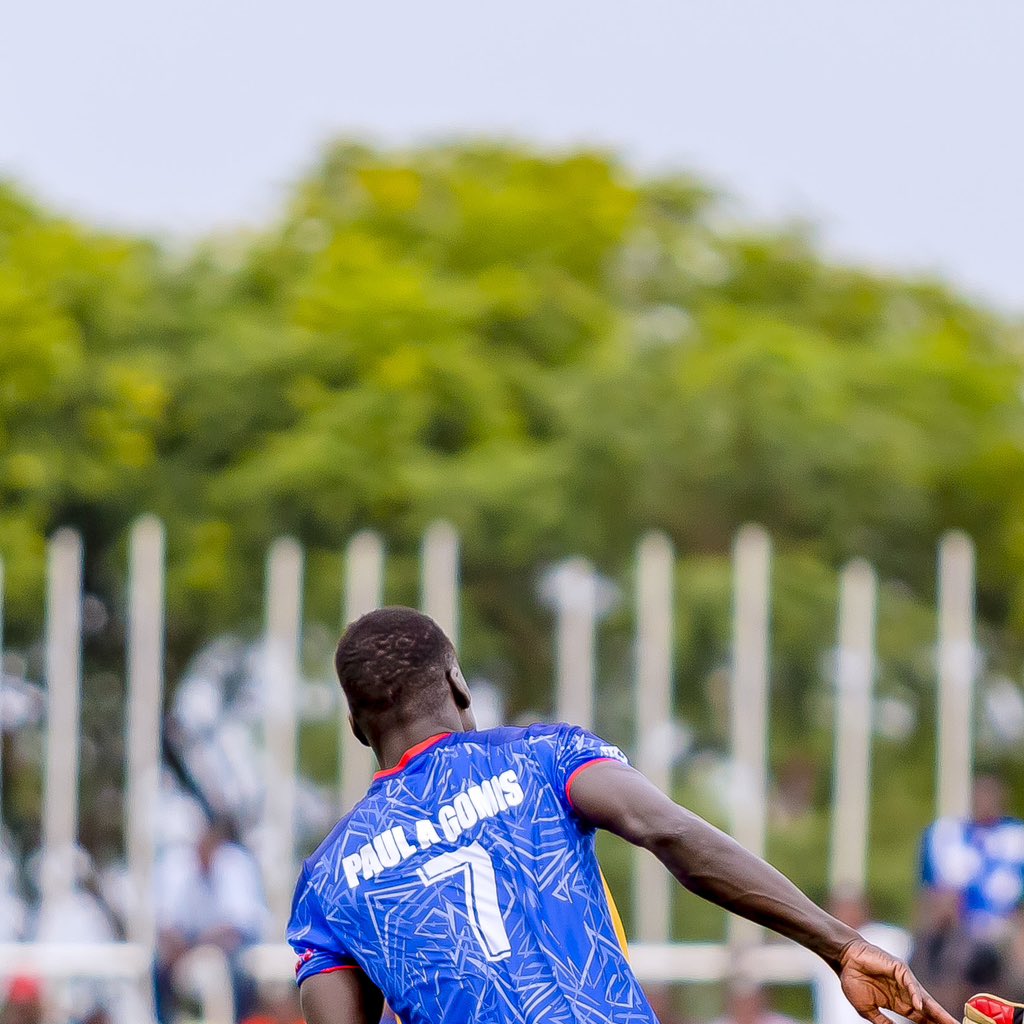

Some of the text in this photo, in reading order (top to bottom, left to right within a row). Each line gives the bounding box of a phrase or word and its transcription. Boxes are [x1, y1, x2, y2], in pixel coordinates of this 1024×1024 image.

[342, 769, 525, 889] PAUL A GOMIS
[415, 838, 512, 962] 7
